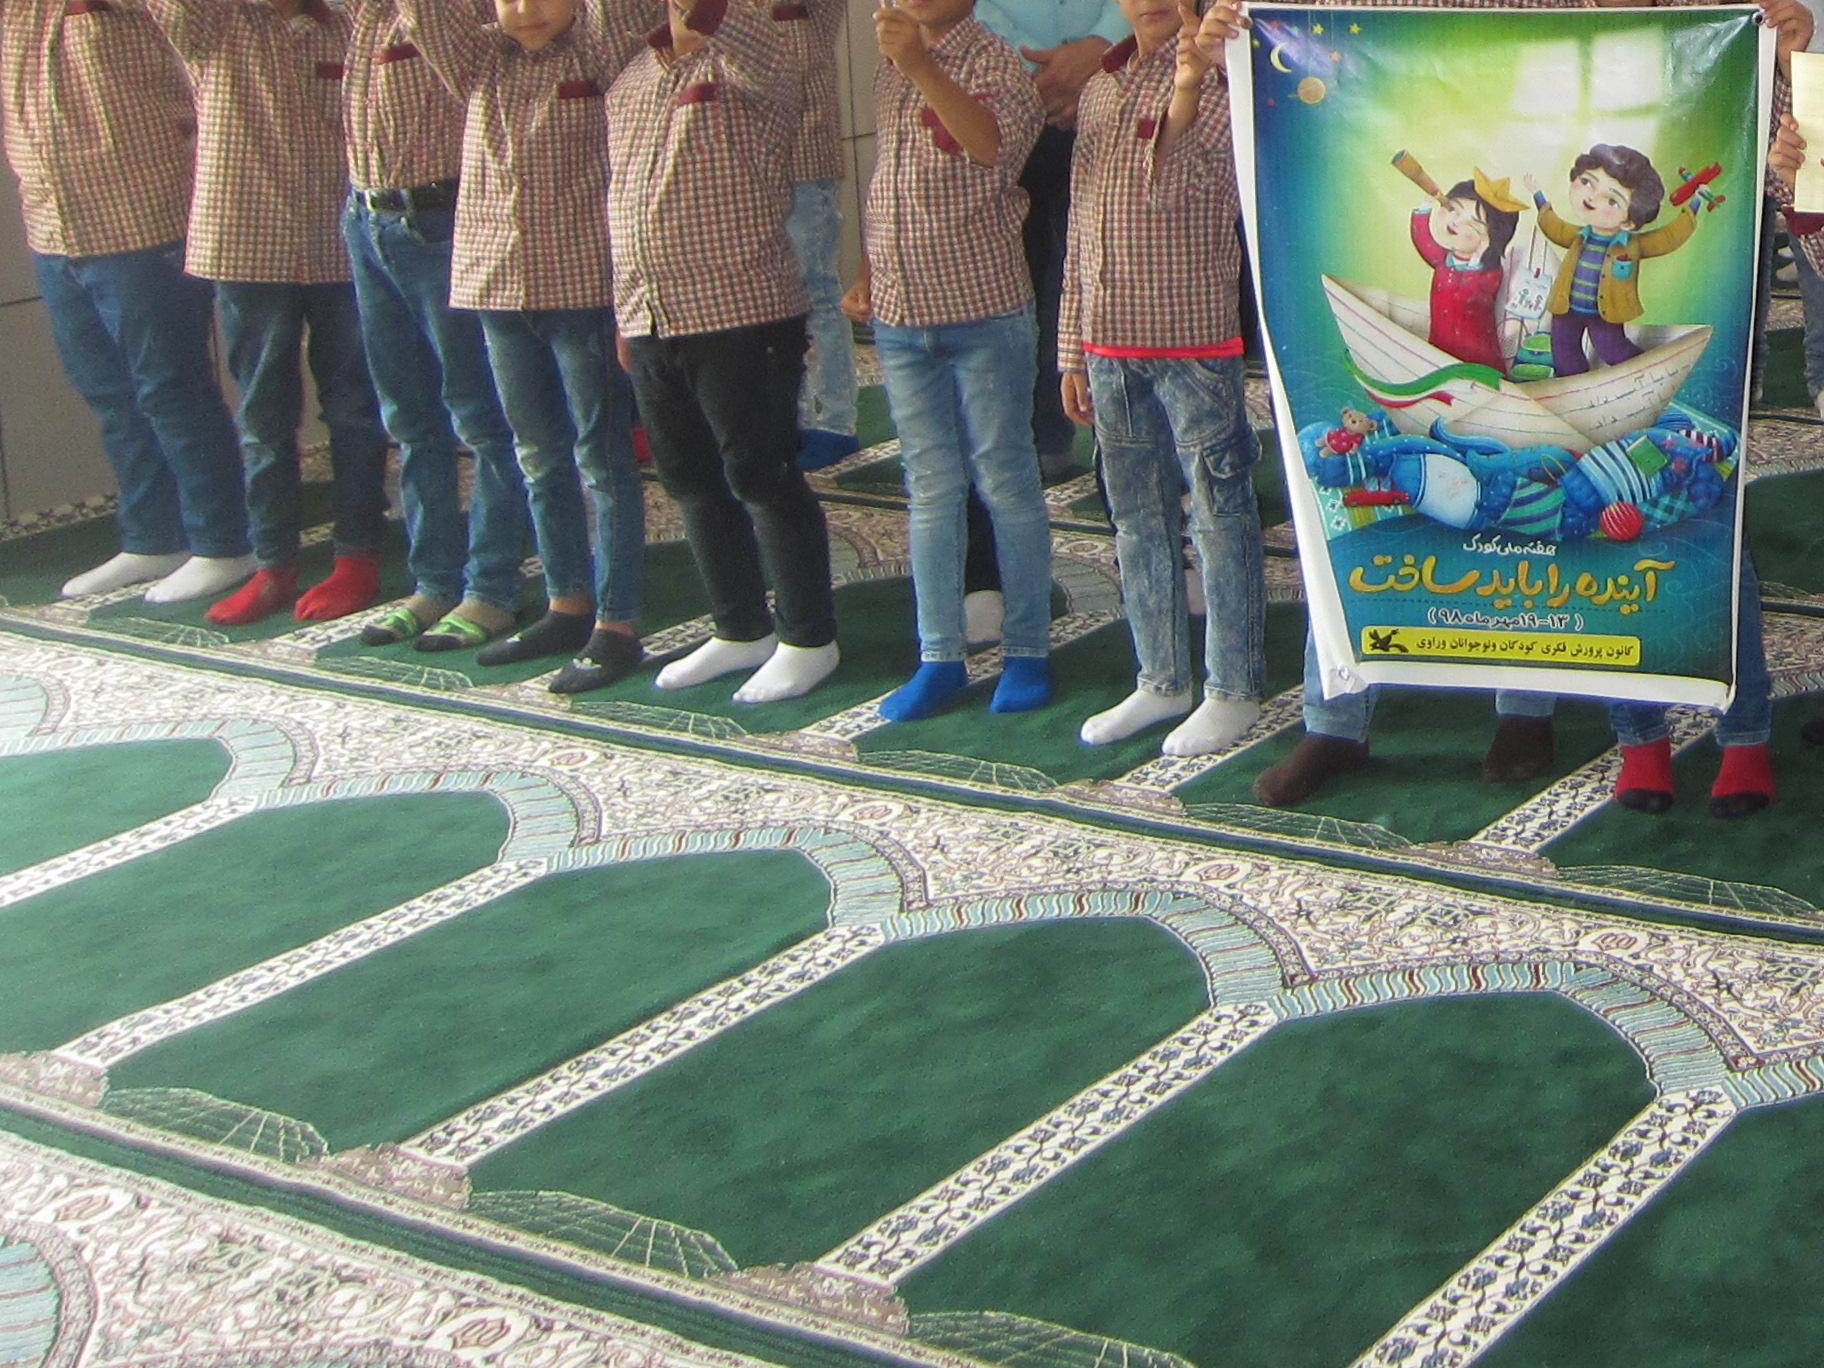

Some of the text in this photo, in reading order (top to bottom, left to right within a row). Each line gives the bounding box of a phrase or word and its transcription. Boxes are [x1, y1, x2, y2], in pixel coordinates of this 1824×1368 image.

[1462, 532, 1557, 556] هفته ملی کودک
[1349, 554, 1676, 614] آینده را باید ساخت
[1416, 636, 1447, 650] وراوی
[1499, 640, 1537, 655] کودکان
[1541, 641, 1567, 656] فکری
[1570, 643, 1604, 659] پرورش
[1606, 645, 1634, 660] کانون
